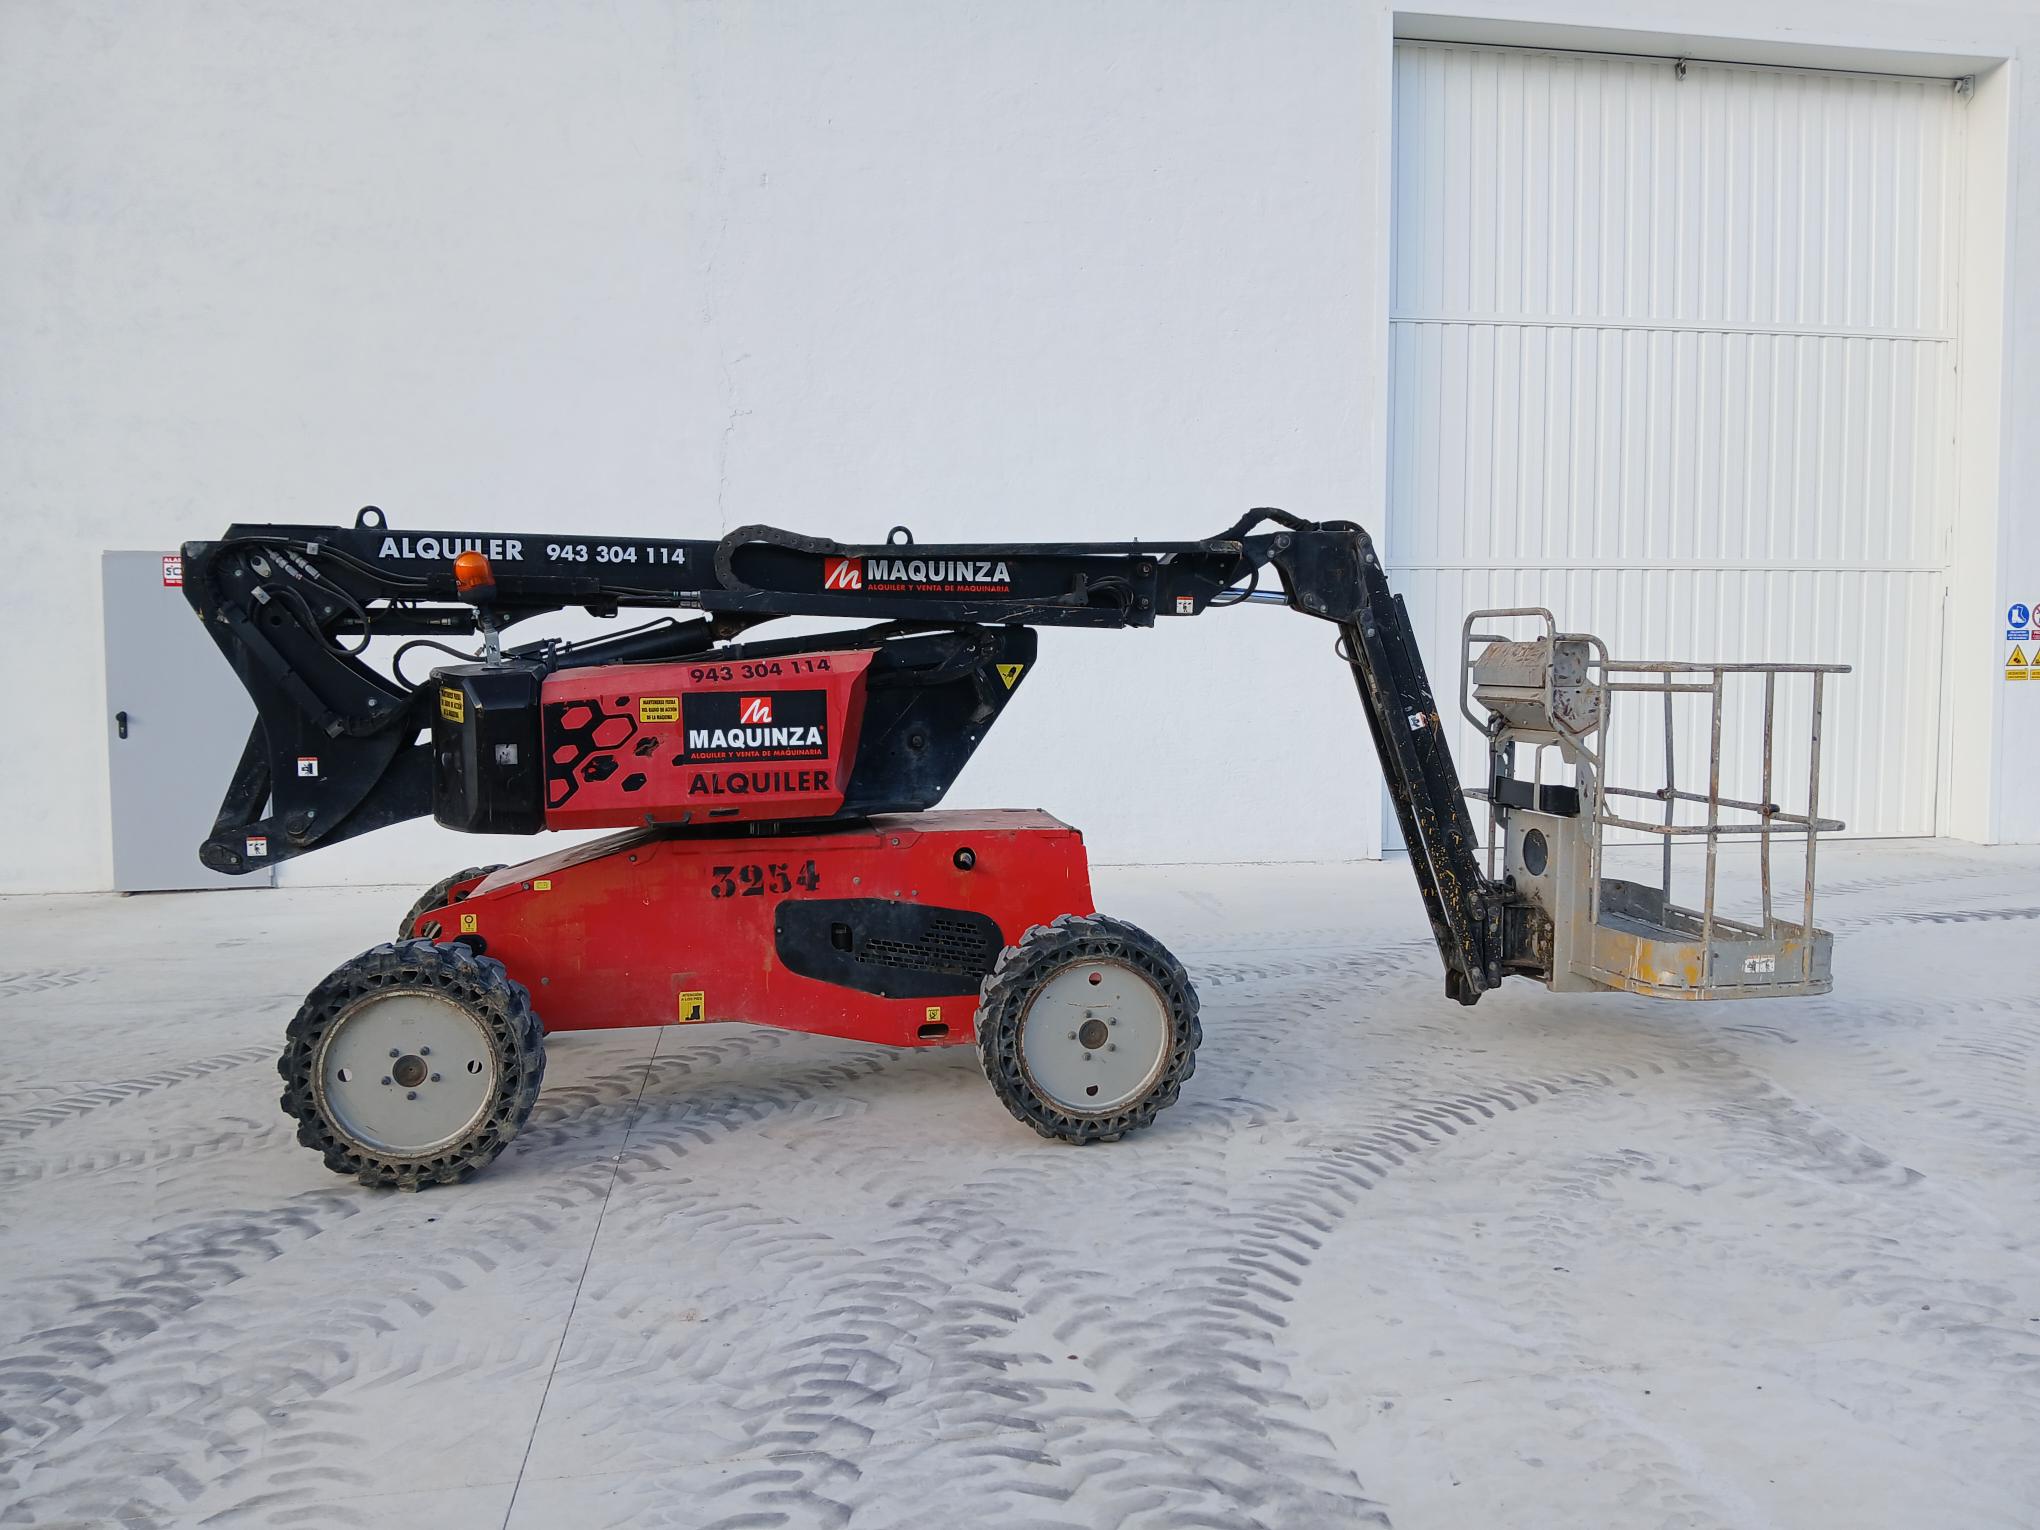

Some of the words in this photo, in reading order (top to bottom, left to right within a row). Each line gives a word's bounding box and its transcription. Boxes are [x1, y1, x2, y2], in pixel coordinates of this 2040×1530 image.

[379, 537, 524, 562] ALQUILER
[547, 544, 588, 562] 943
[596, 545, 637, 563] 304
[647, 547, 685, 565] 114
[868, 560, 1010, 583] MAQUINZA
[956, 585, 1010, 593] MAQUINARIA
[690, 666, 733, 682] 943
[741, 662, 782, 679] 304
[791, 659, 830, 673] 114
[689, 727, 822, 749] MAQUINZA
[773, 749, 822, 757] MAQUINARIA
[689, 771, 830, 795] ALQUILER
[711, 860, 820, 898] 3254
